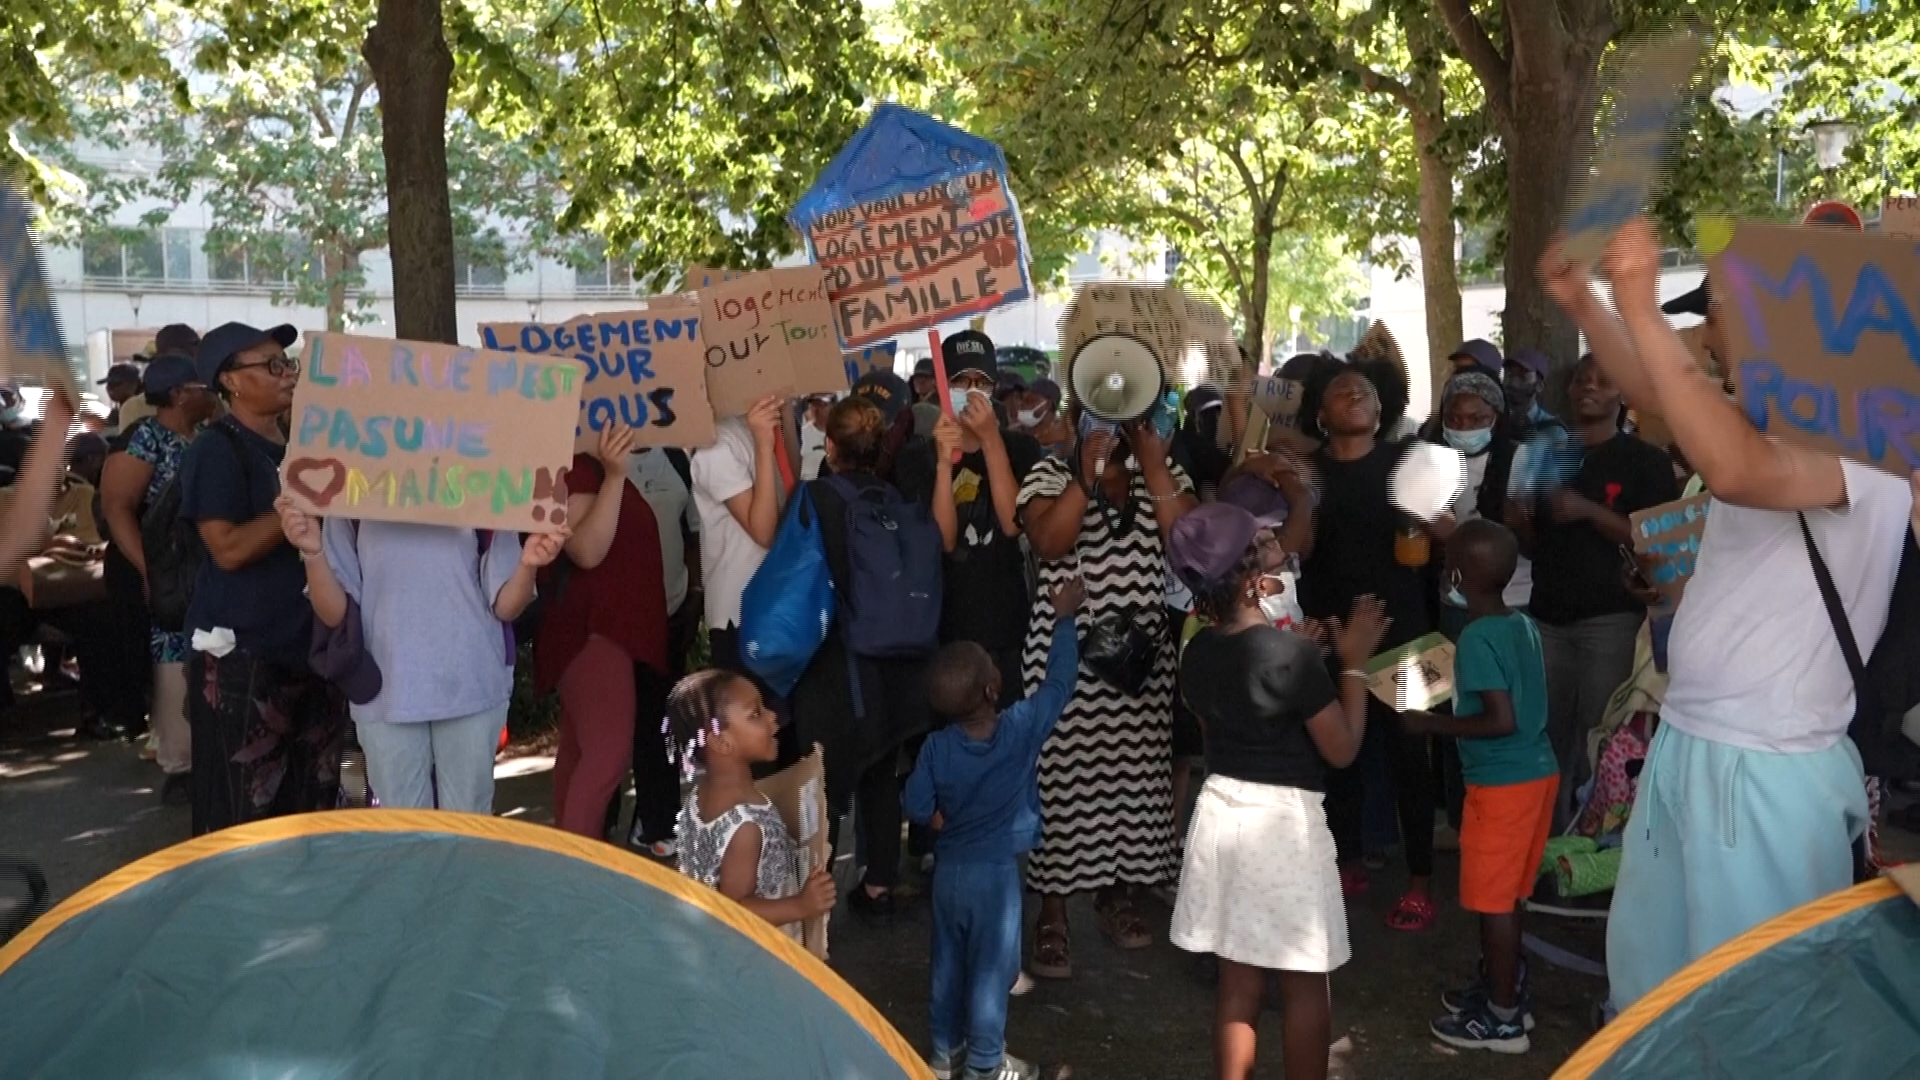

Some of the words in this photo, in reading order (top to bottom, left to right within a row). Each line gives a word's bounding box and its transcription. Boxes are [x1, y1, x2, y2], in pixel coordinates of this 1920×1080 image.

[808, 203, 967, 262] LOGEMENT
[840, 267, 998, 337] FAMILLE
[483, 317, 699, 353] LOGEMENT
[309, 337, 371, 387] LA
[391, 346, 475, 392] RUE
[574, 349, 655, 384] OUR
[577, 388, 676, 436] OUS
